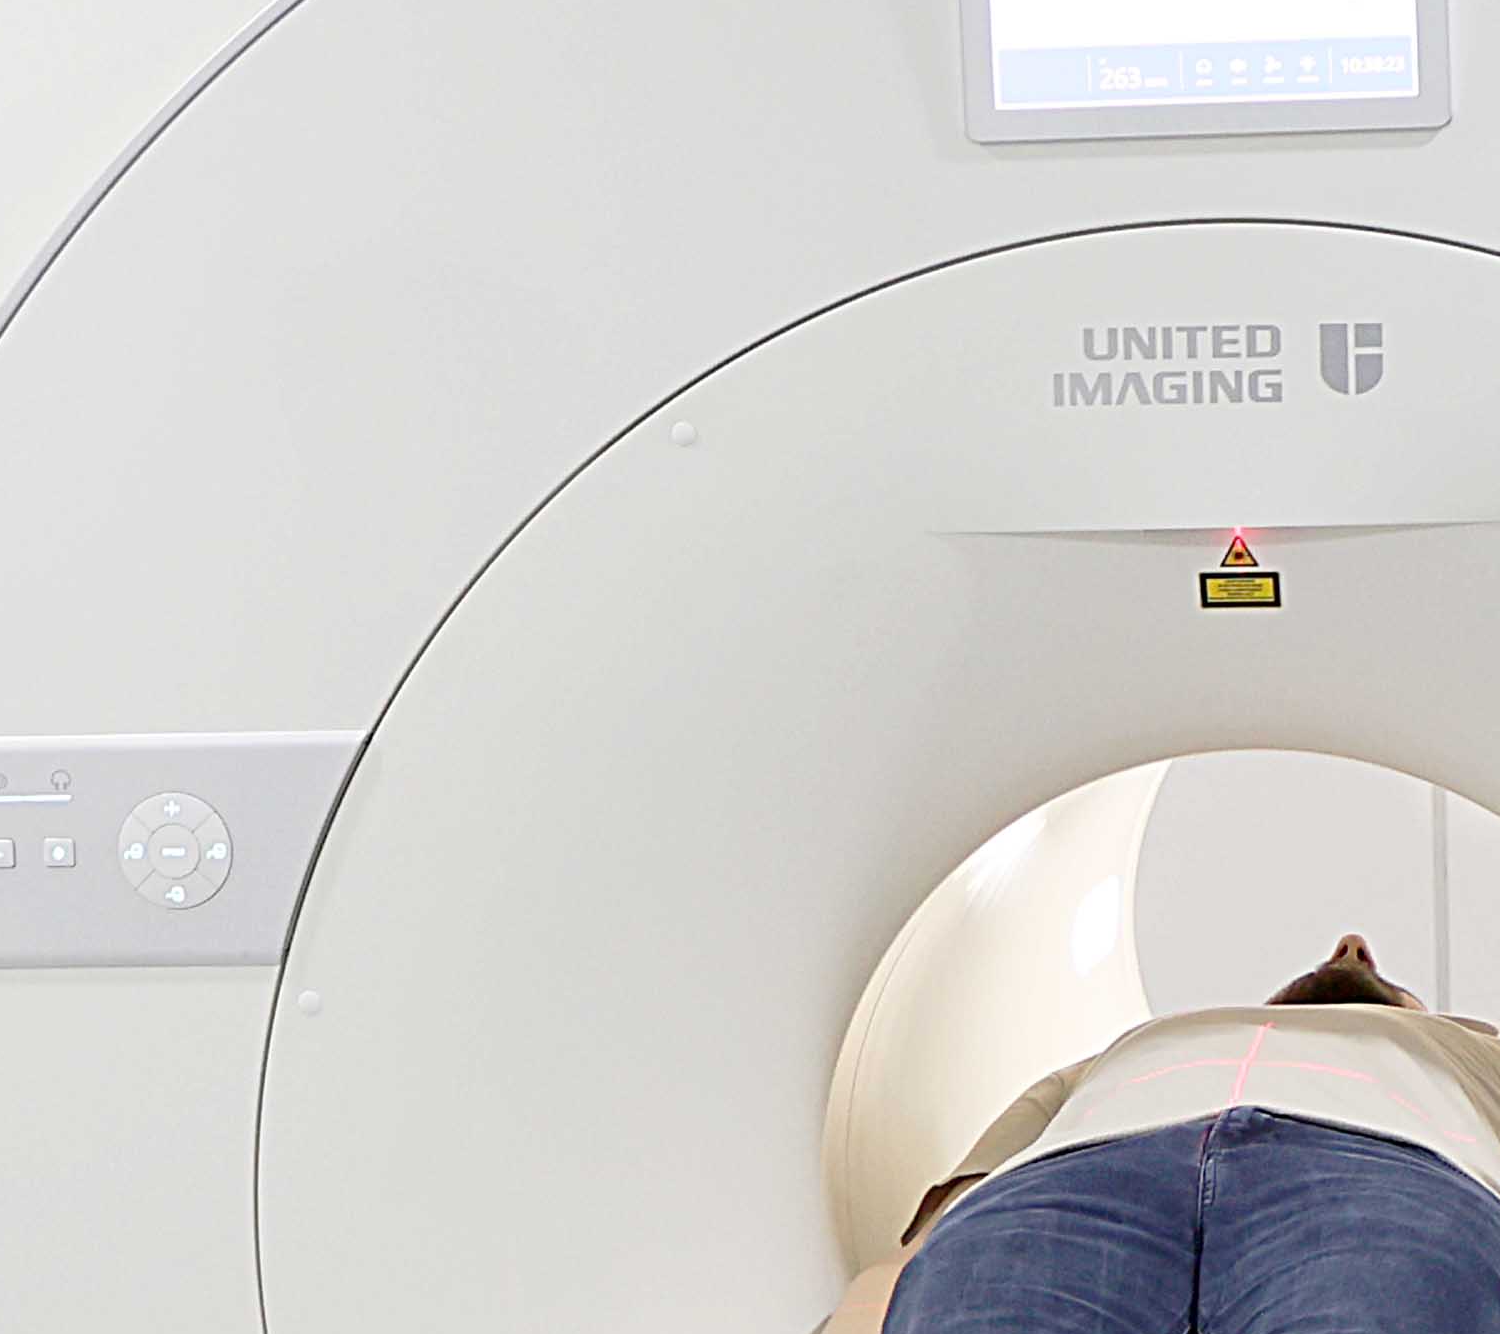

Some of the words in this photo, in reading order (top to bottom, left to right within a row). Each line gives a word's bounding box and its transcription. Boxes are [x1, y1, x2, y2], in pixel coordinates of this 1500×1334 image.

[1099, 66, 1142, 91] 263
[1082, 324, 1282, 362] UNITED
[1052, 369, 1283, 407] IMAGING
